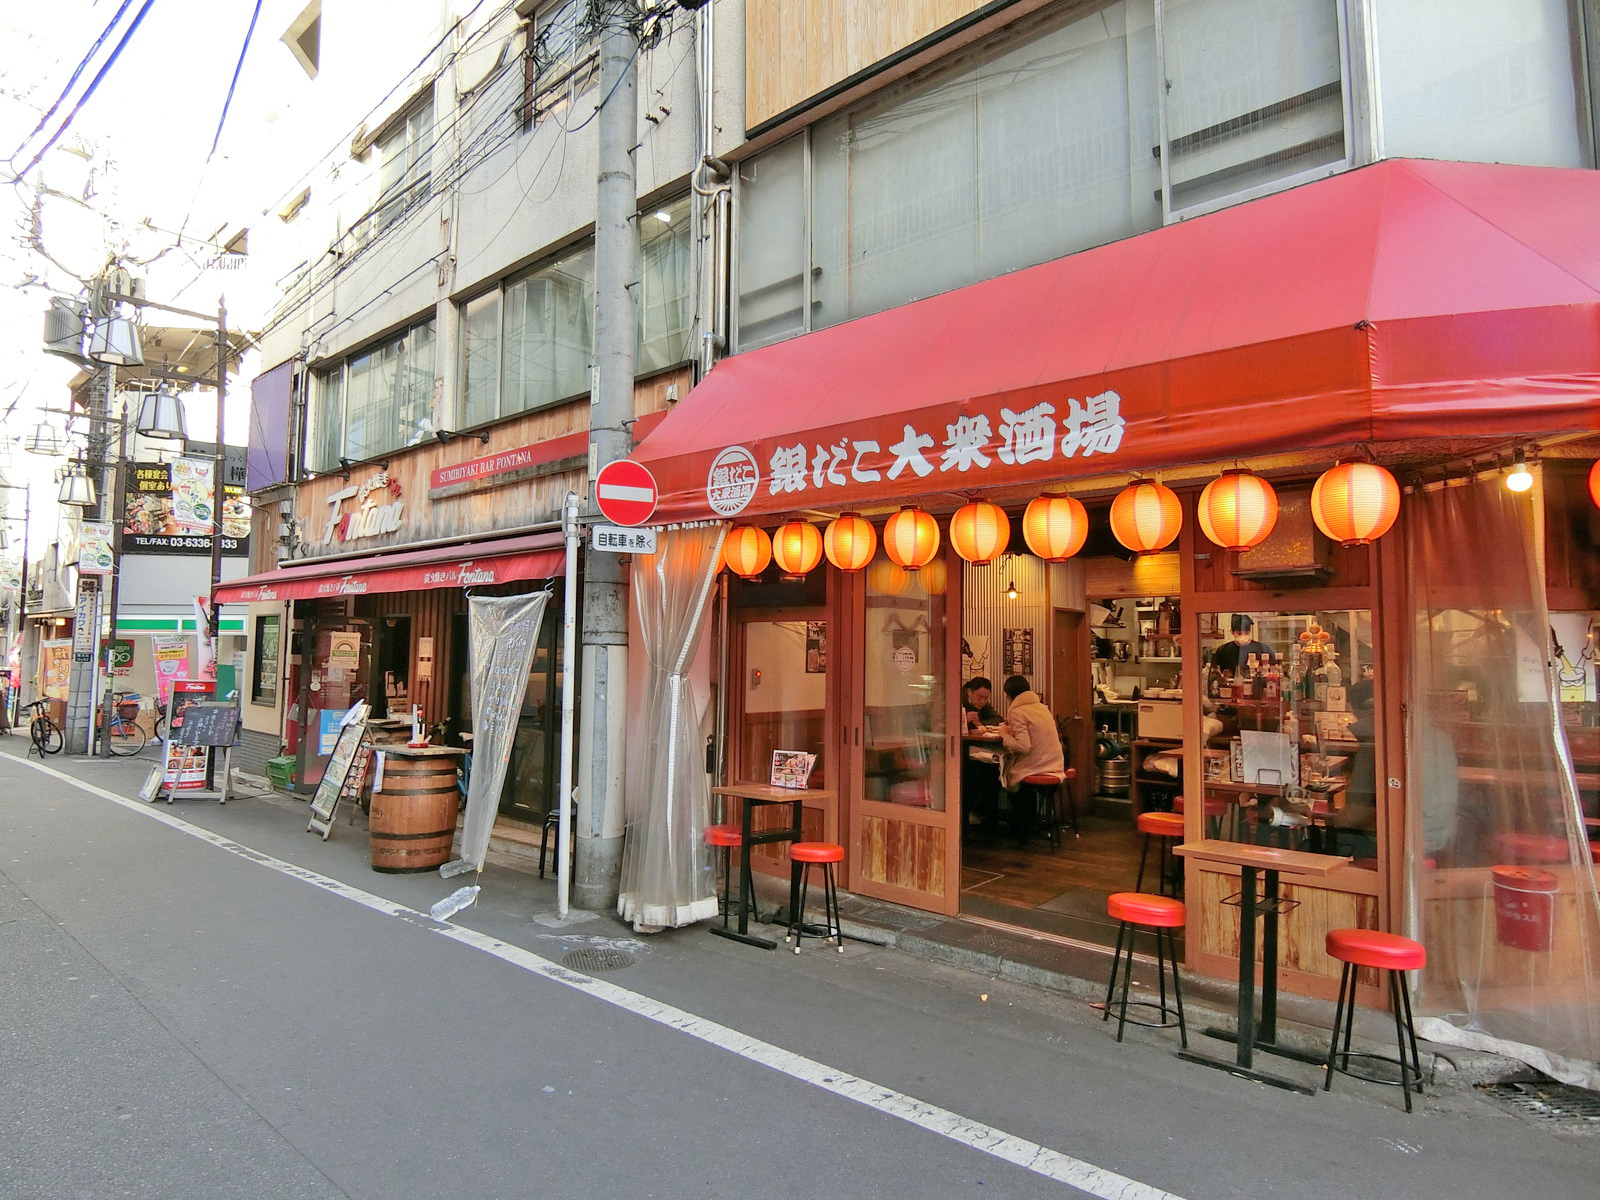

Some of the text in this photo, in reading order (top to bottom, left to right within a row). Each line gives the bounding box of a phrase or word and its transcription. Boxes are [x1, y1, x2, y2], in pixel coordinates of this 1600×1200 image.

[769, 390, 1126, 496] 銀だこ大衆酒場
[440, 450, 532, 483] SUMIBIYAKI BAR FONTANA
[713, 463, 755, 487] 銀だこ
[712, 484, 751, 500] 大衆酒場
[323, 485, 404, 546] Fontana
[135, 537, 170, 546] TEL/FAX:
[598, 532, 652, 549] 自転車を除く
[457, 561, 495, 585] Fontana
